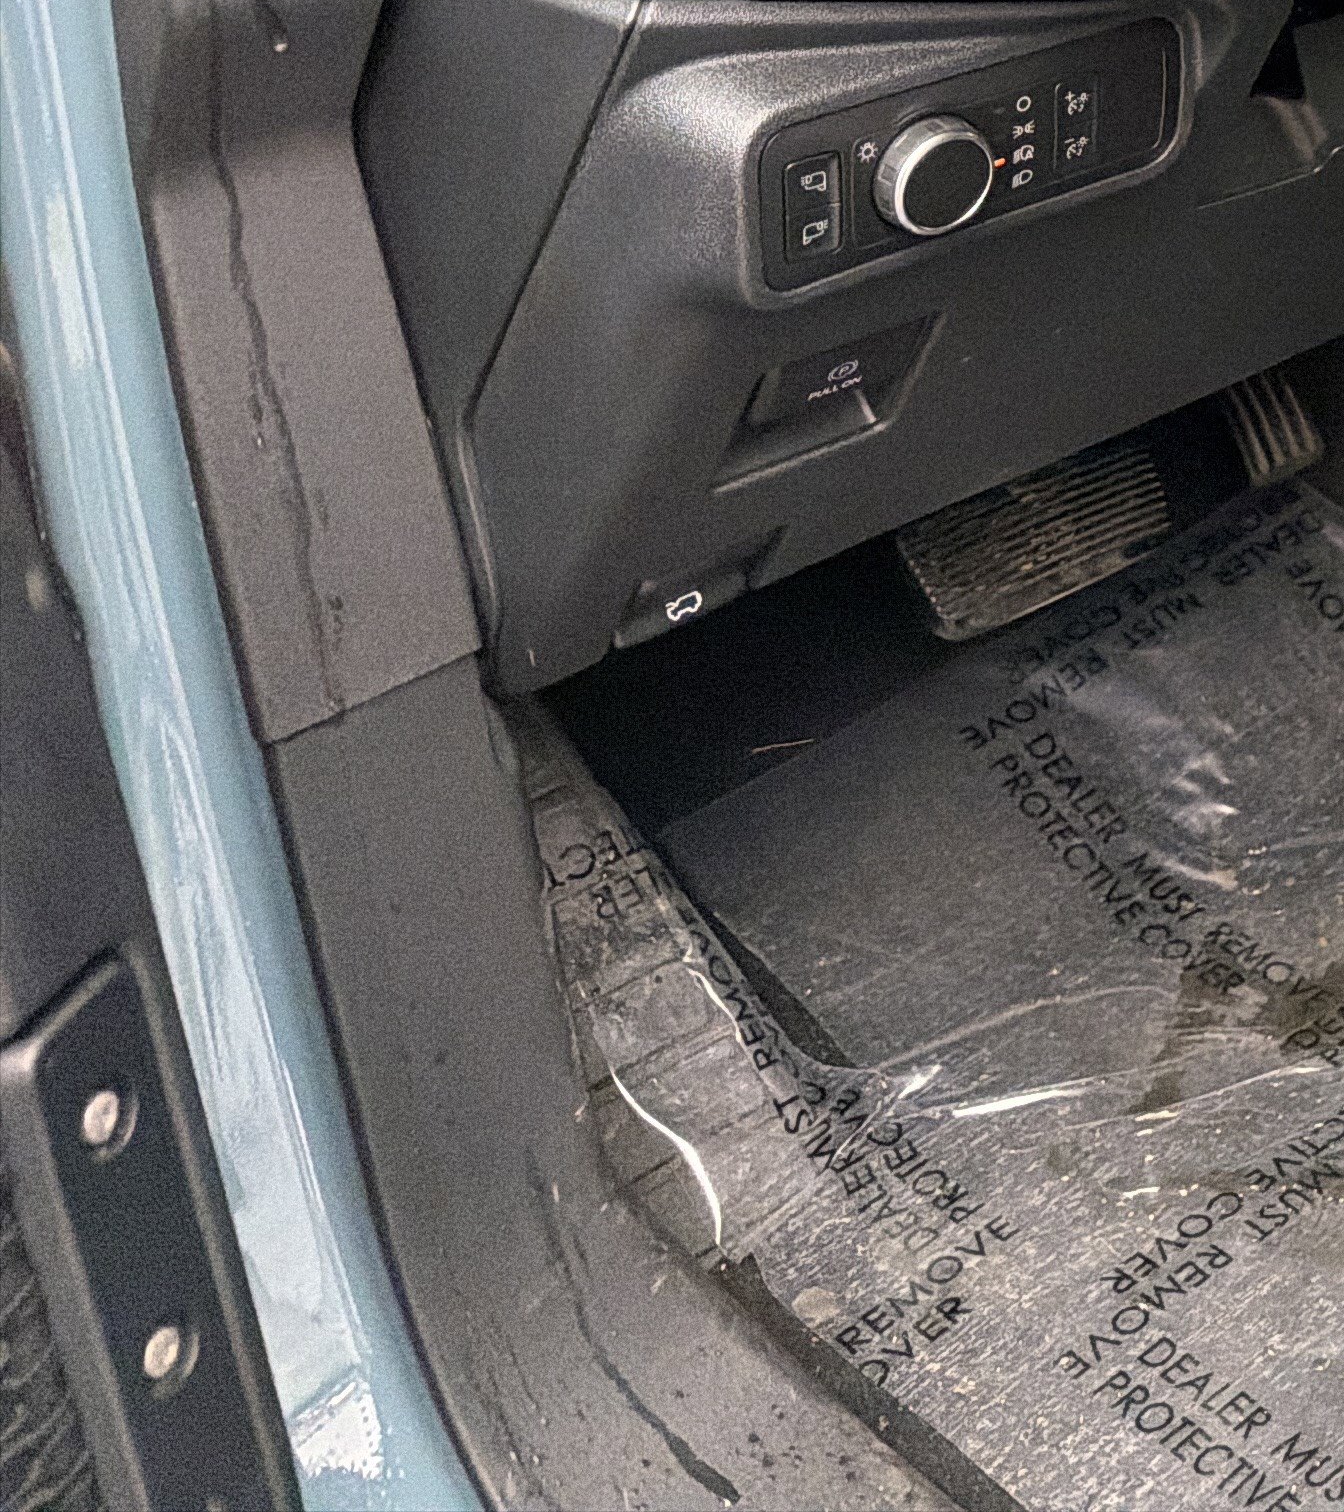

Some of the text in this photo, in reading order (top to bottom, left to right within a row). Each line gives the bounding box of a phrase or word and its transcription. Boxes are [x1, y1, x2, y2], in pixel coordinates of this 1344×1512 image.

[807, 375, 862, 401] PULL ON
[1120, 592, 1204, 650] MUST
[958, 647, 1110, 750] REMOVE
[989, 751, 1150, 927] PROTECTIVE
[1024, 732, 1130, 846] DEALER
[1119, 852, 1207, 923] MUST
[1099, 1189, 1245, 1297] COVER
[1244, 1149, 1344, 1243] MUST
[834, 1214, 1022, 1355] REMOVE
[1052, 1242, 1234, 1381] REMOVE
[859, 1294, 975, 1388] OVER
[1135, 1334, 1275, 1442] DEALER
